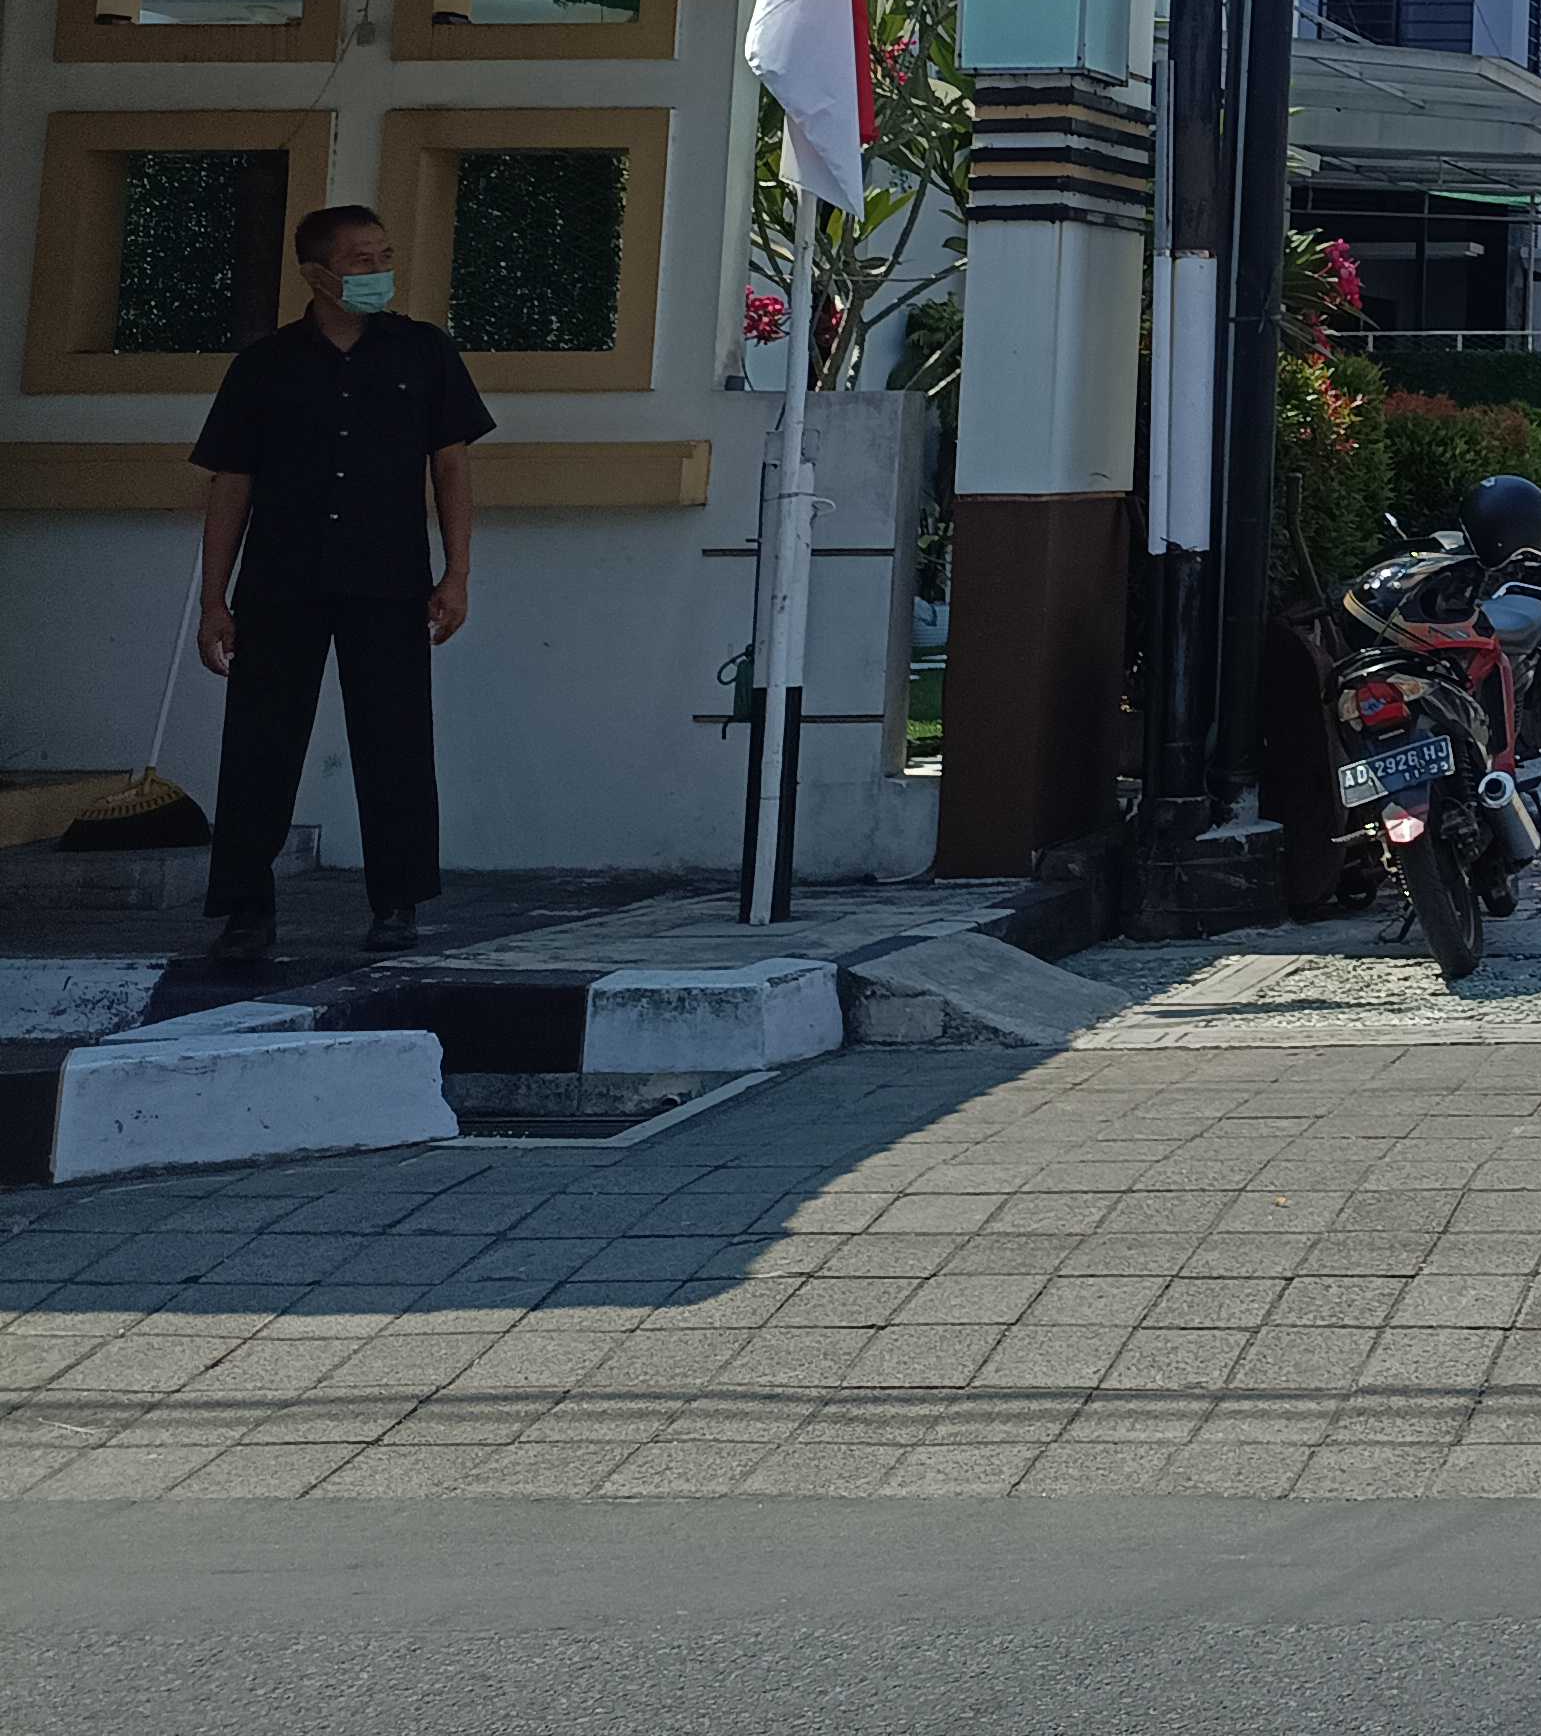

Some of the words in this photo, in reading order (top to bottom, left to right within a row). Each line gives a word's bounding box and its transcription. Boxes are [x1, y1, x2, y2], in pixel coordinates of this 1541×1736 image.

[1345, 765, 1368, 788] AD
[1375, 750, 1419, 777] 2926
[1423, 741, 1448, 761] HJ
